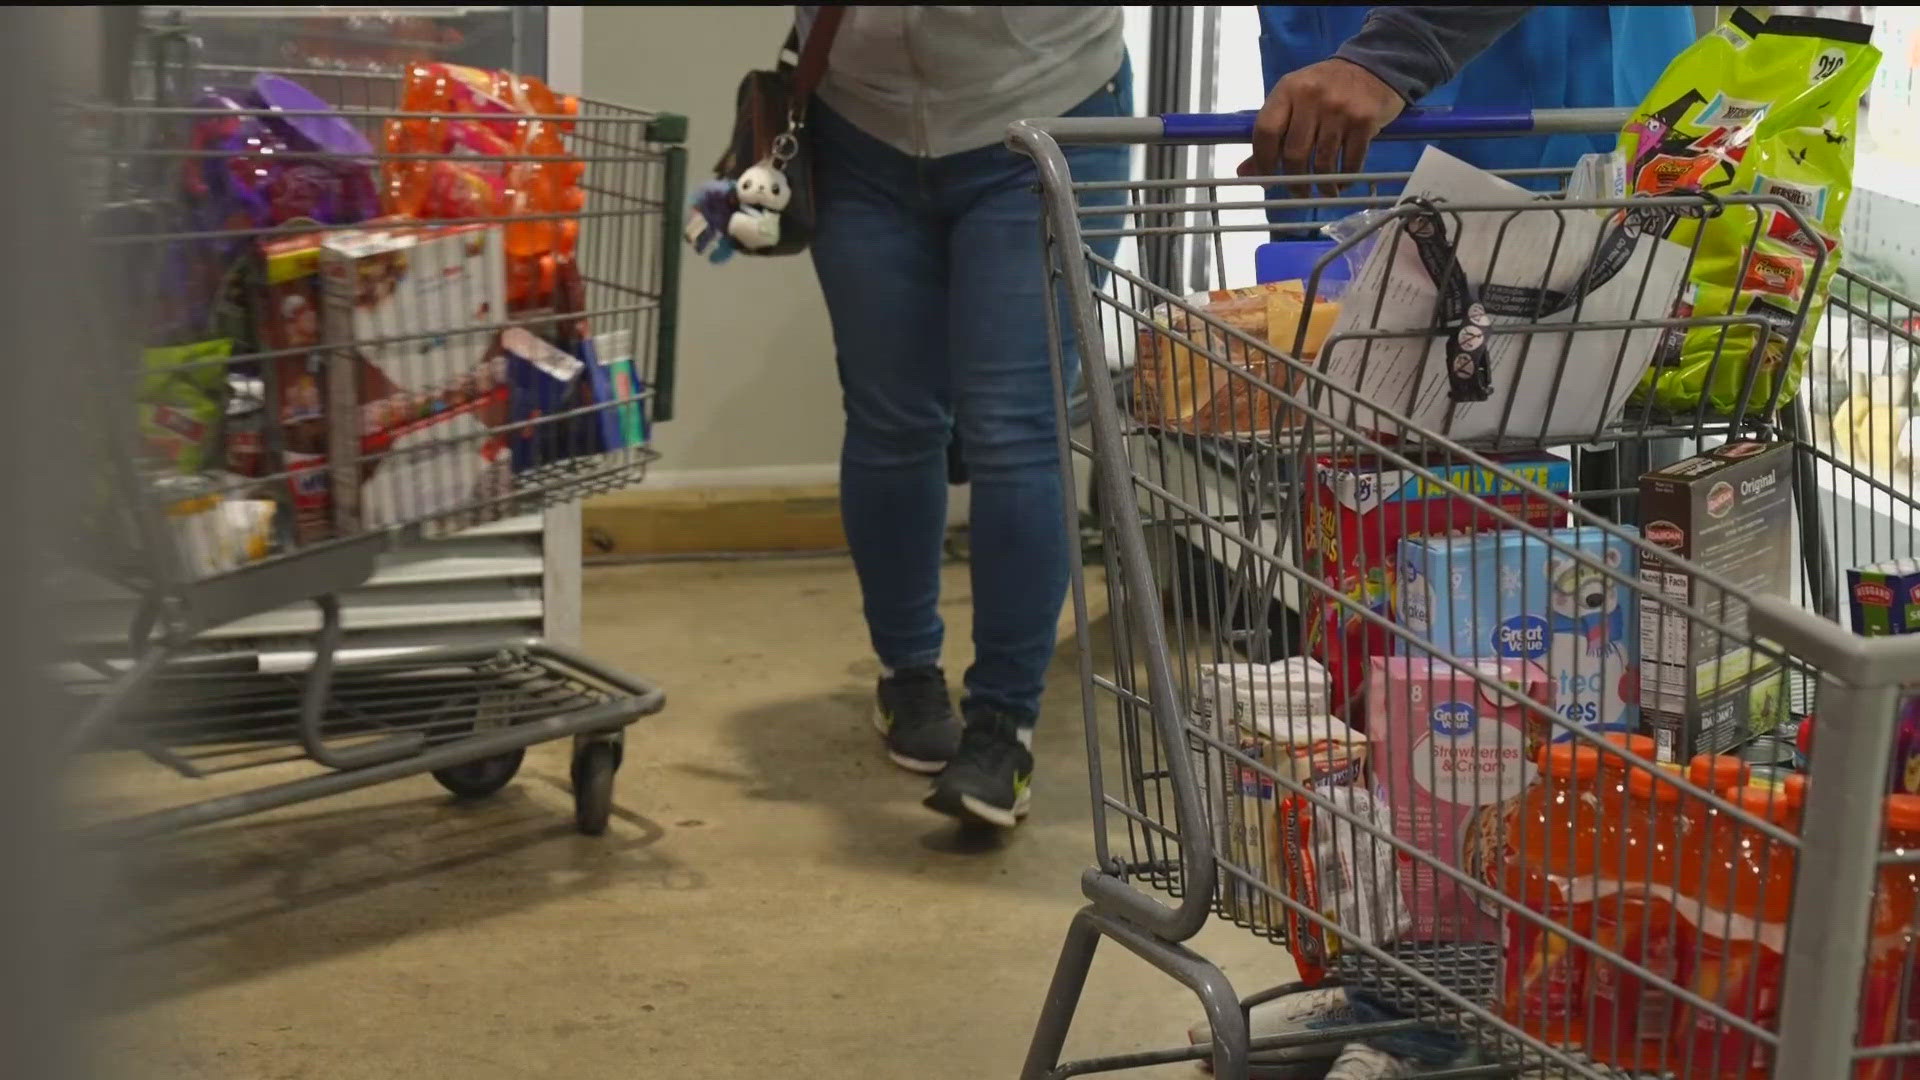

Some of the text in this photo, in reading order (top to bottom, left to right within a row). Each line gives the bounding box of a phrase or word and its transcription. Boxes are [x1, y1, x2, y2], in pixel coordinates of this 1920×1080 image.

[1502, 466, 1549, 492] SIZE
[1741, 470, 1776, 496] Original
[1309, 502, 1337, 539] Lcky
[1641, 571, 1687, 588] Nutritin Facts
[1501, 625, 1543, 642] Great
[1508, 640, 1543, 652] Vaue
[1411, 684, 1422, 702] 8
[1433, 708, 1470, 722] Grat
[1432, 744, 1519, 759] Strwberres
[1442, 759, 1506, 773] & Cram
